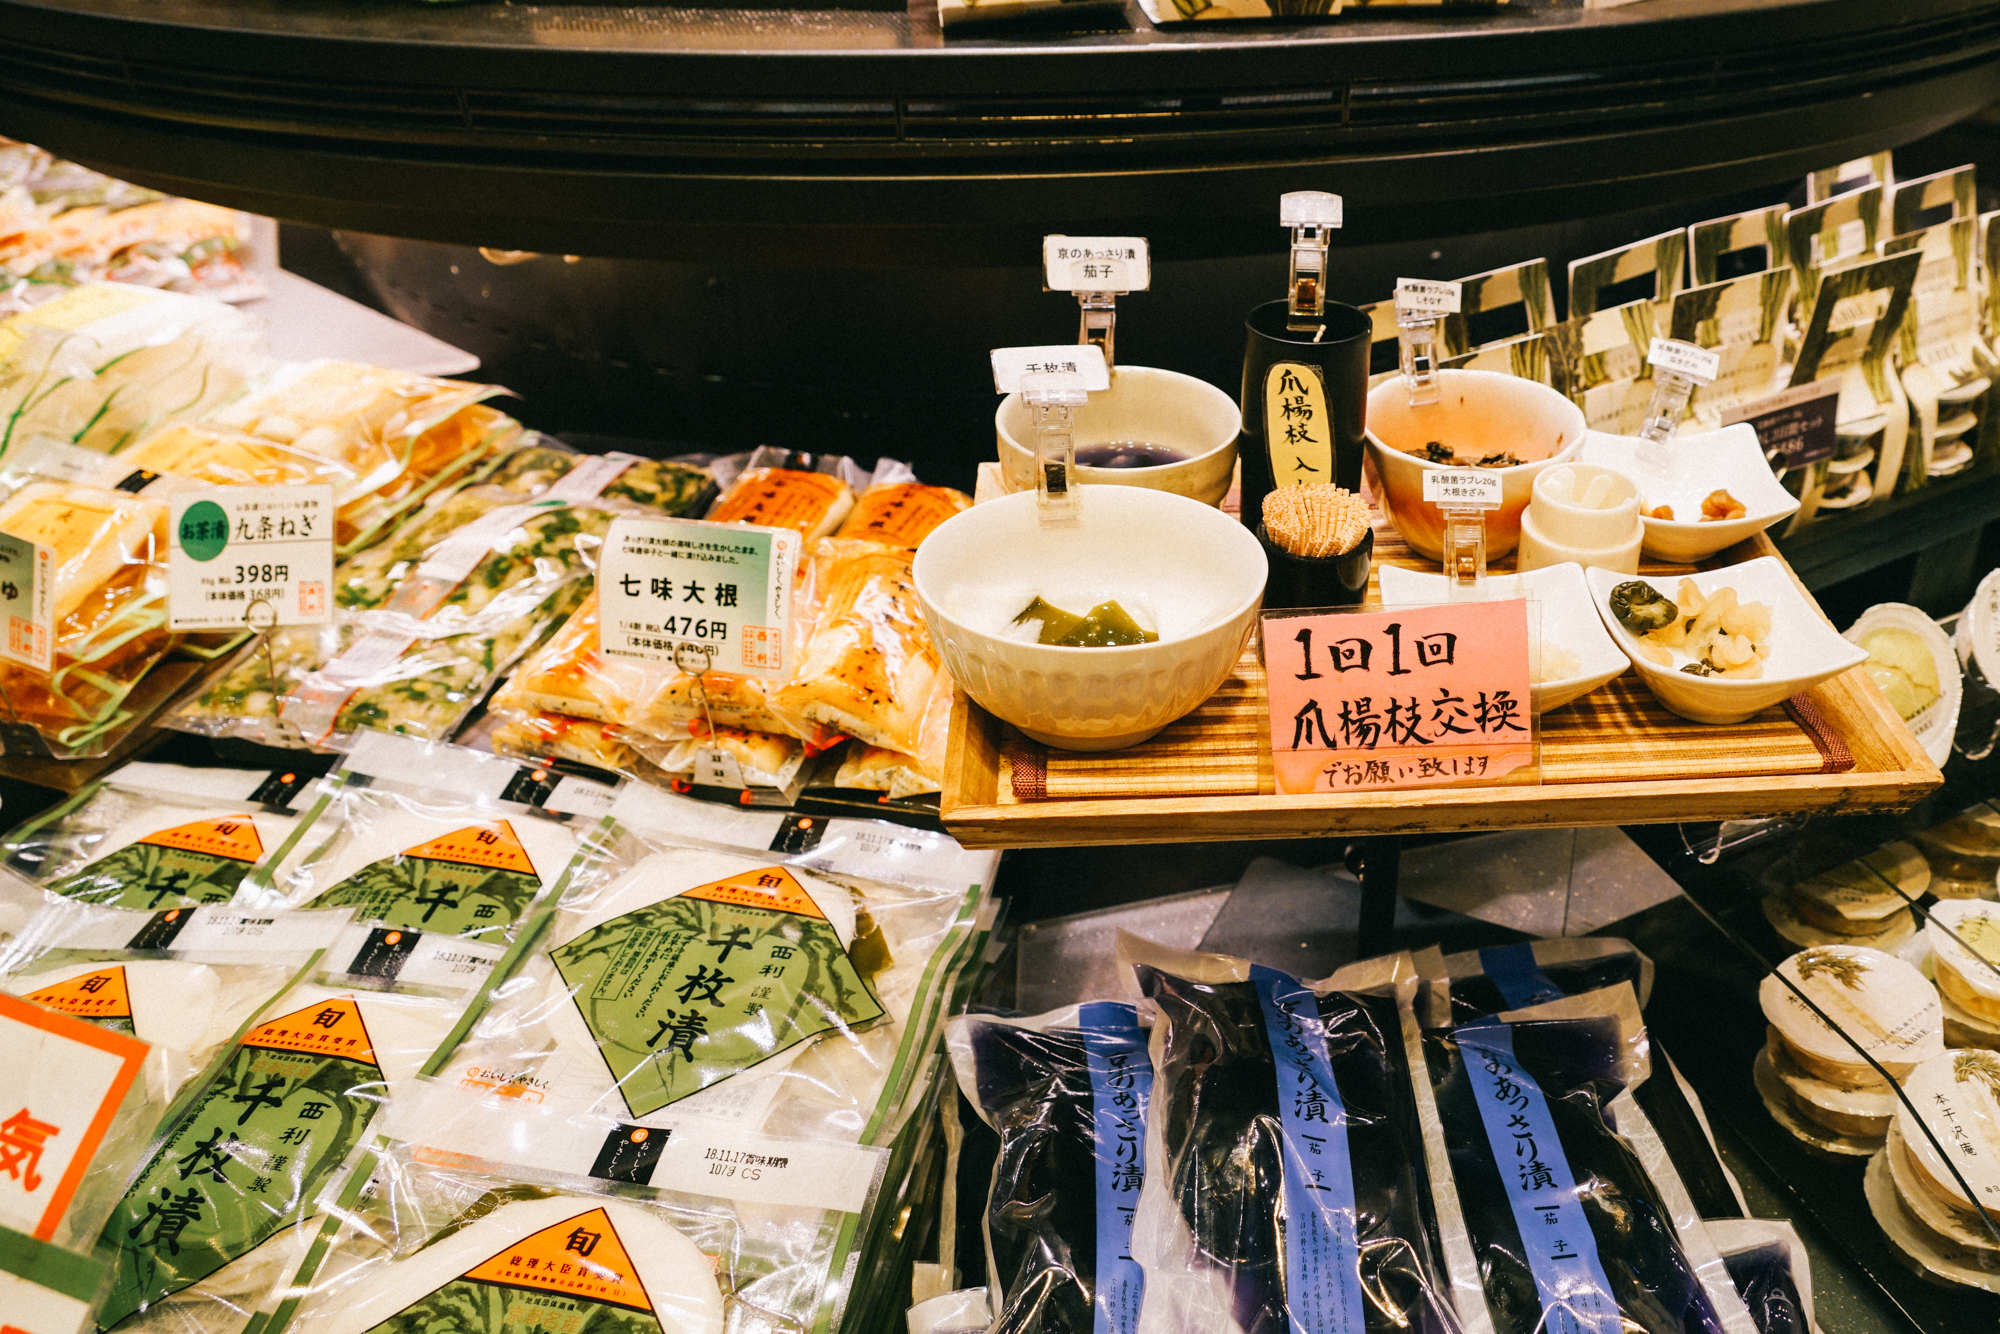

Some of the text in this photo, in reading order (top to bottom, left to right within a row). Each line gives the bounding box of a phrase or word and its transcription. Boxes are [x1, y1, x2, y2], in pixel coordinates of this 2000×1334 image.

[1057, 248, 1136, 260] 京のあっさり漬
[1083, 264, 1113, 279] 茄子
[1277, 368, 1319, 485] 爪楊枝入
[1430, 475, 1497, 487] 乳酸菌ラブレ20g
[1442, 487, 1486, 497] 大根きざみ
[234, 513, 318, 540] 九条ねぎ
[235, 564, 289, 584] 398円
[619, 573, 738, 607] 七味大根
[664, 615, 727, 640] 476円
[1294, 623, 1458, 681] 1回1回
[1291, 688, 1529, 752] 爪楊枝交換
[757, 873, 783, 889] 旬
[79, 975, 112, 993] 旬
[646, 926, 753, 1063] 千枚漬
[312, 1007, 346, 1029] 旬
[128, 1076, 286, 1257] 千枚漬
[741, 1167, 762, 1181] CS
[1308, 1142, 1326, 1183] 茄子
[564, 1226, 602, 1257] 旬
[1543, 1212, 1568, 1253] 茄子
